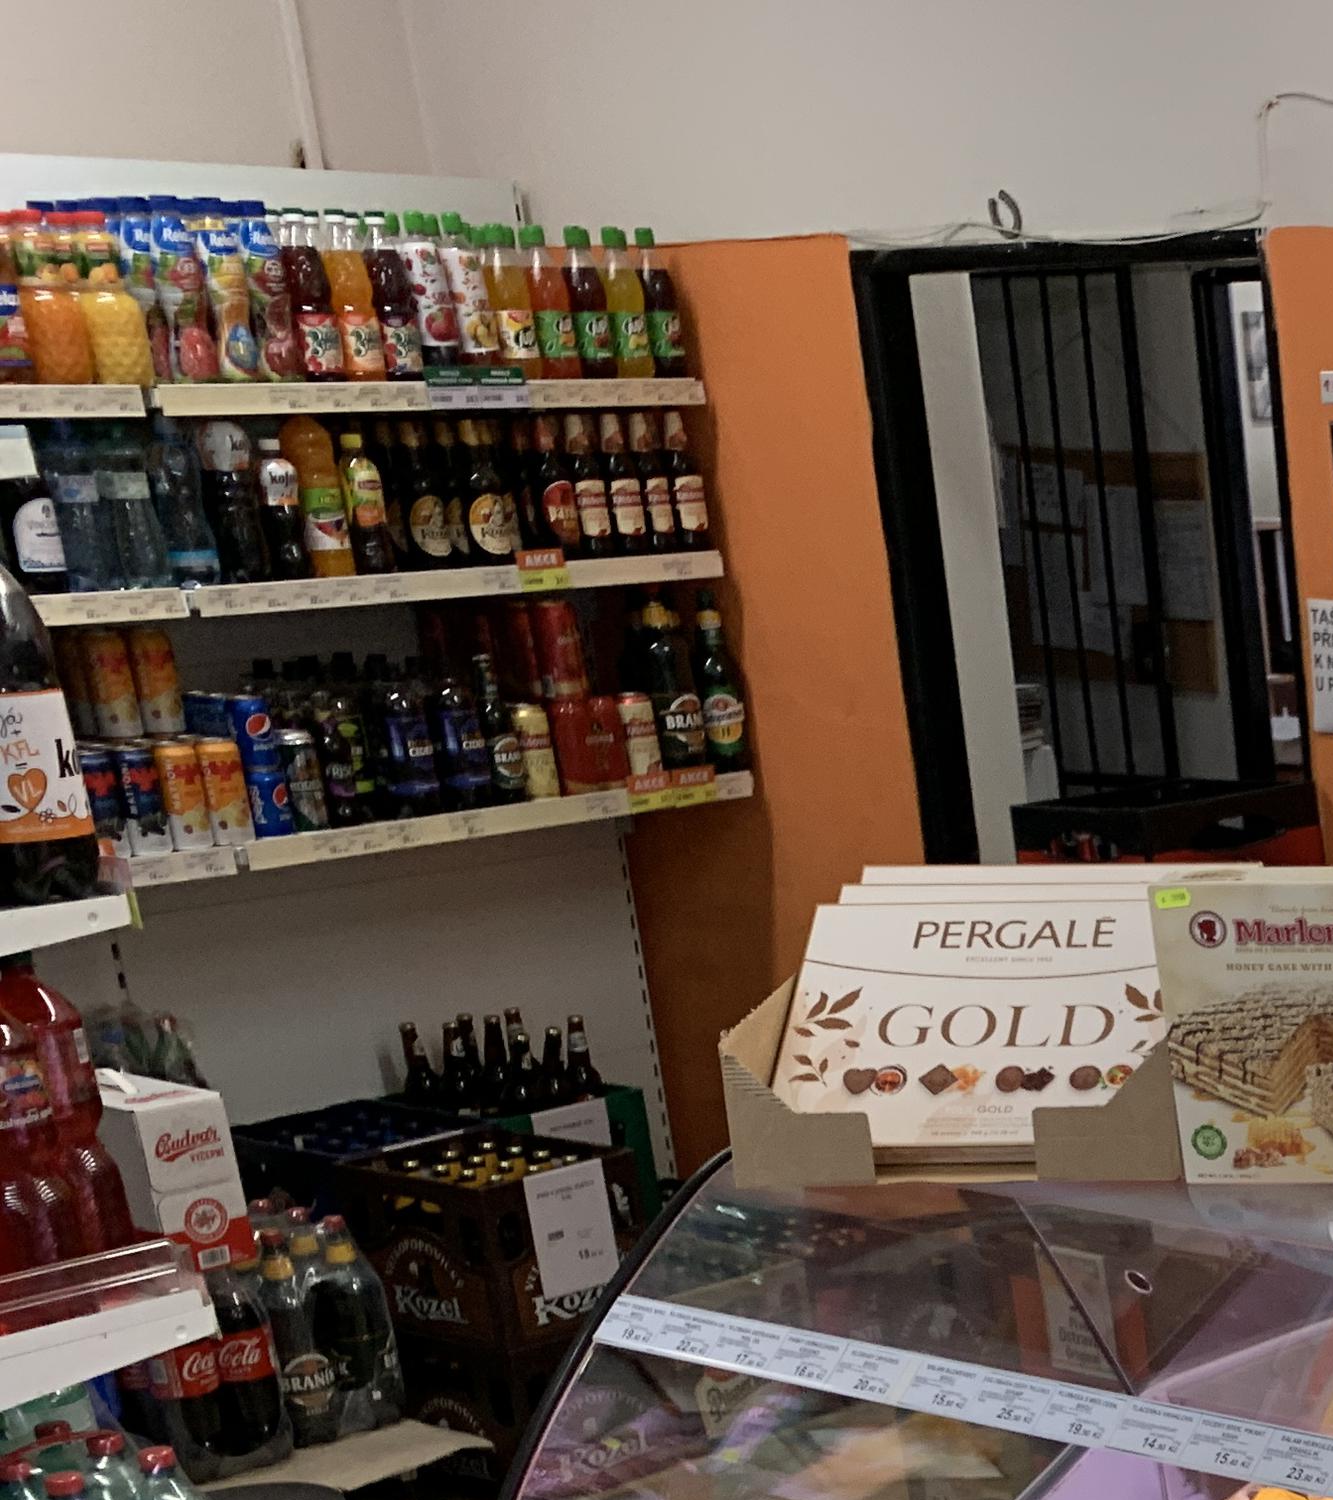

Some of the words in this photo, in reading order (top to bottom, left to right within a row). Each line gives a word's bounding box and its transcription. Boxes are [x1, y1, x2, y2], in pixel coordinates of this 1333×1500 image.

[877, 1003, 1116, 1049] GOLD
[154, 1130, 222, 1162] Budvar
[395, 1285, 467, 1325] Kozel
[218, 1335, 262, 1370] Cola
